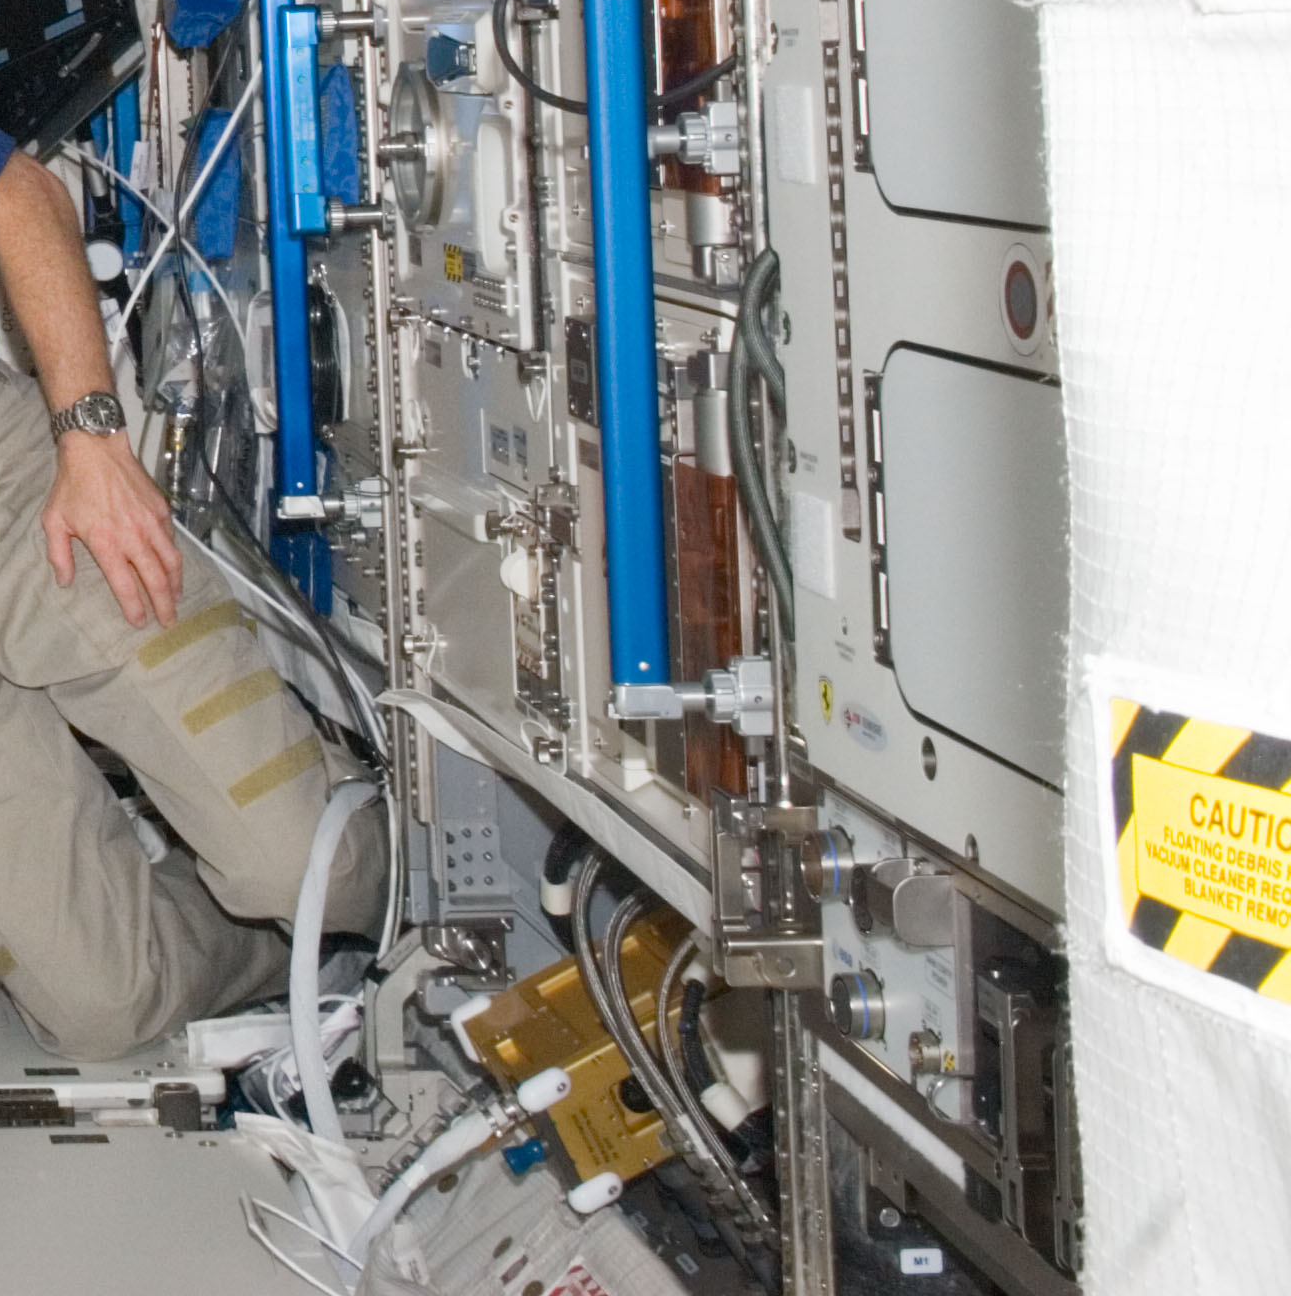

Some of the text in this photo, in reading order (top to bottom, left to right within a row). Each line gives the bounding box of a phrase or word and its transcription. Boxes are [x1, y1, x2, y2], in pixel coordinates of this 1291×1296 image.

[1189, 792, 1291, 853] CAUTIO
[1145, 839, 1189, 873] VACUUM
[1193, 859, 1256, 896] CLEANER
[1163, 825, 1223, 860] FLOATING
[1226, 847, 1282, 879] DEBRIS
[1184, 876, 1243, 913] BLANKET
[913, 1256, 929, 1266] M1
